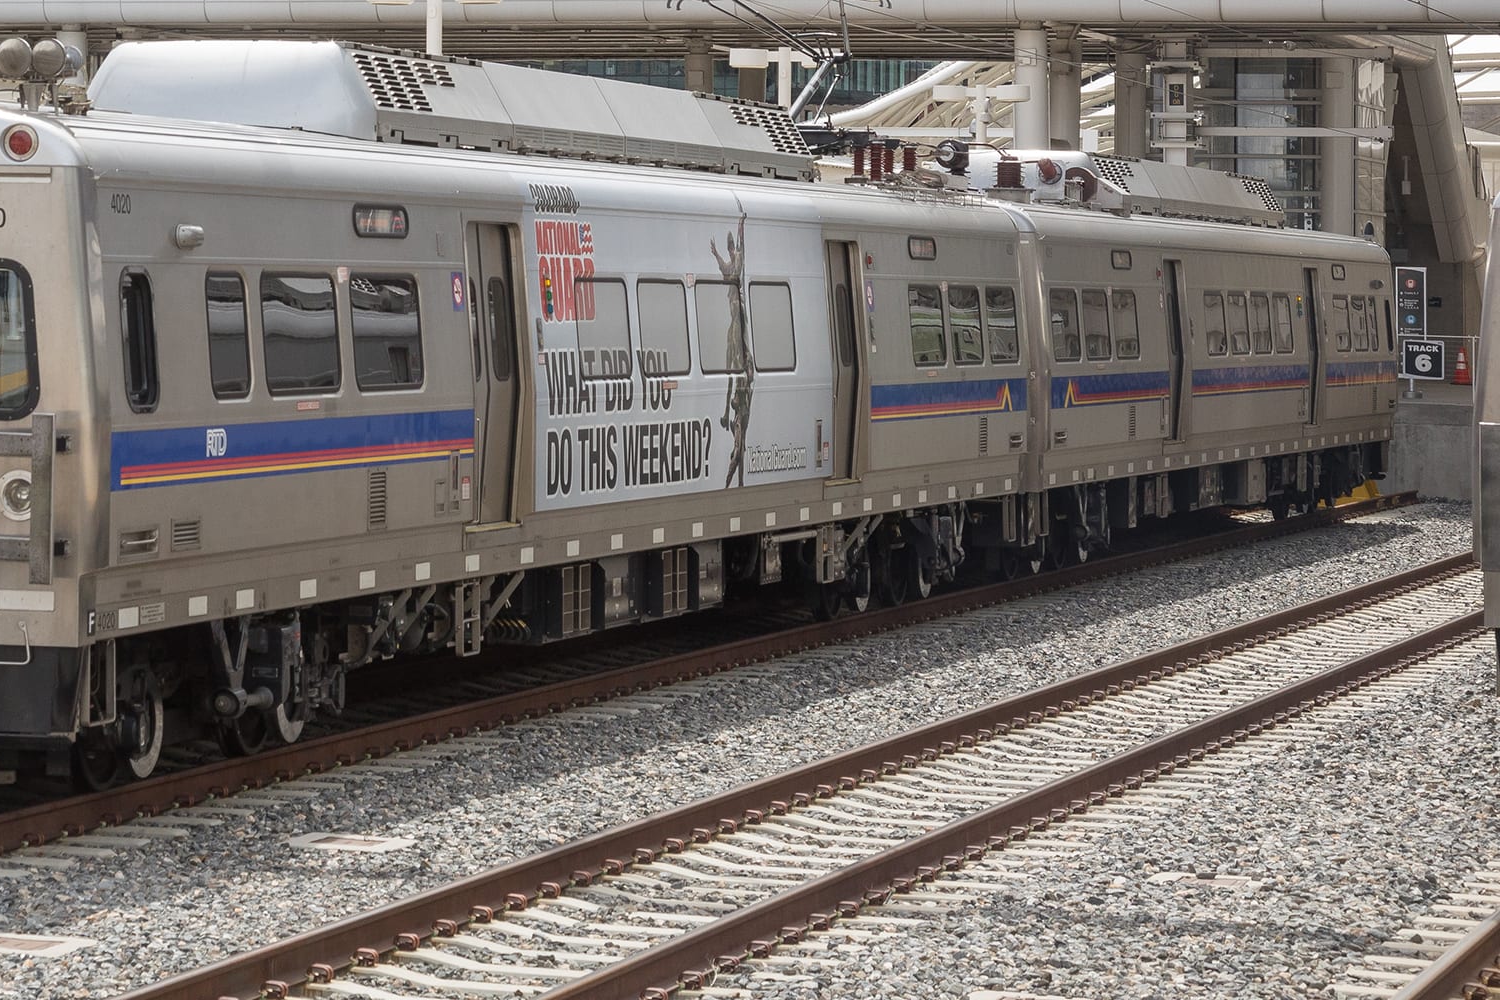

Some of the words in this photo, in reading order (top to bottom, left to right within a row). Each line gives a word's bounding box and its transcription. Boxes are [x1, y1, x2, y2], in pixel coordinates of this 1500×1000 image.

[111, 193, 131, 214] 4020
[528, 183, 580, 214] COLORADO
[535, 220, 581, 255] NATIONAL
[538, 255, 596, 322] GUARD
[1407, 344, 1440, 353] TRACK
[1415, 354, 1433, 373] 6
[543, 350, 597, 416] WHAT
[600, 350, 634, 412] DID
[636, 350, 672, 410] YOU
[206, 428, 227, 457] RTD
[547, 428, 573, 496] DO
[577, 425, 618, 493] THIS
[622, 418, 712, 487] WEEKEND?
[747, 442, 806, 474] NationalGuard.com
[88, 612, 95, 634] F
[98, 612, 116, 630] 4020
